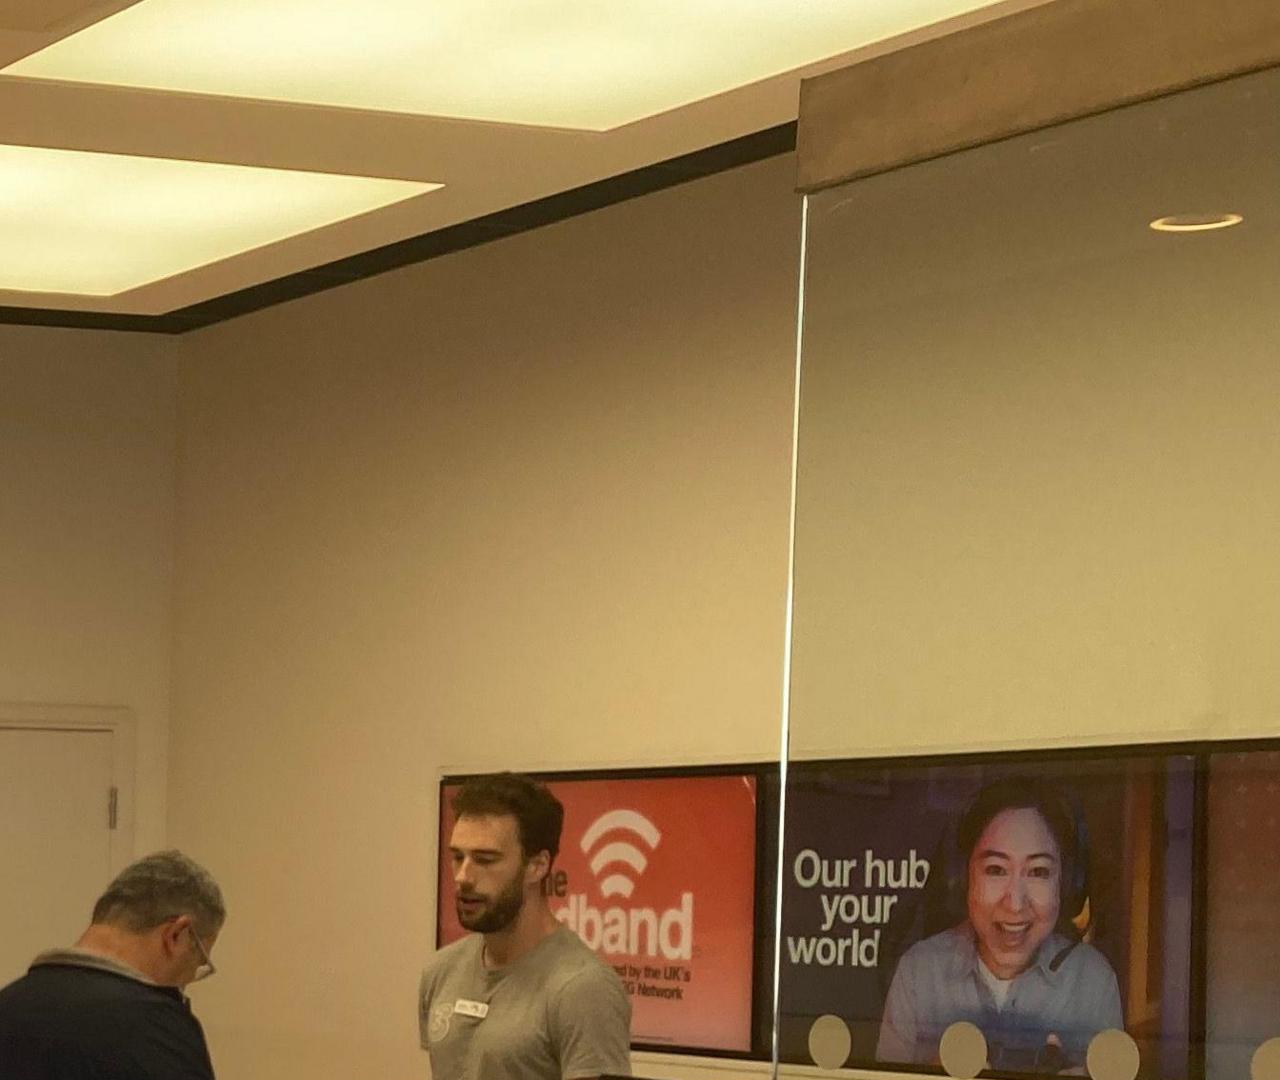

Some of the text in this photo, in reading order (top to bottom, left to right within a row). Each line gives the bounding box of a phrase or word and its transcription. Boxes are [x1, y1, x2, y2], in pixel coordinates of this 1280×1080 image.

[794, 849, 930, 889] Our hub
[821, 894, 898, 931] your
[787, 930, 880, 967] world
[644, 966, 661, 979] the
[638, 983, 683, 1000] Network
